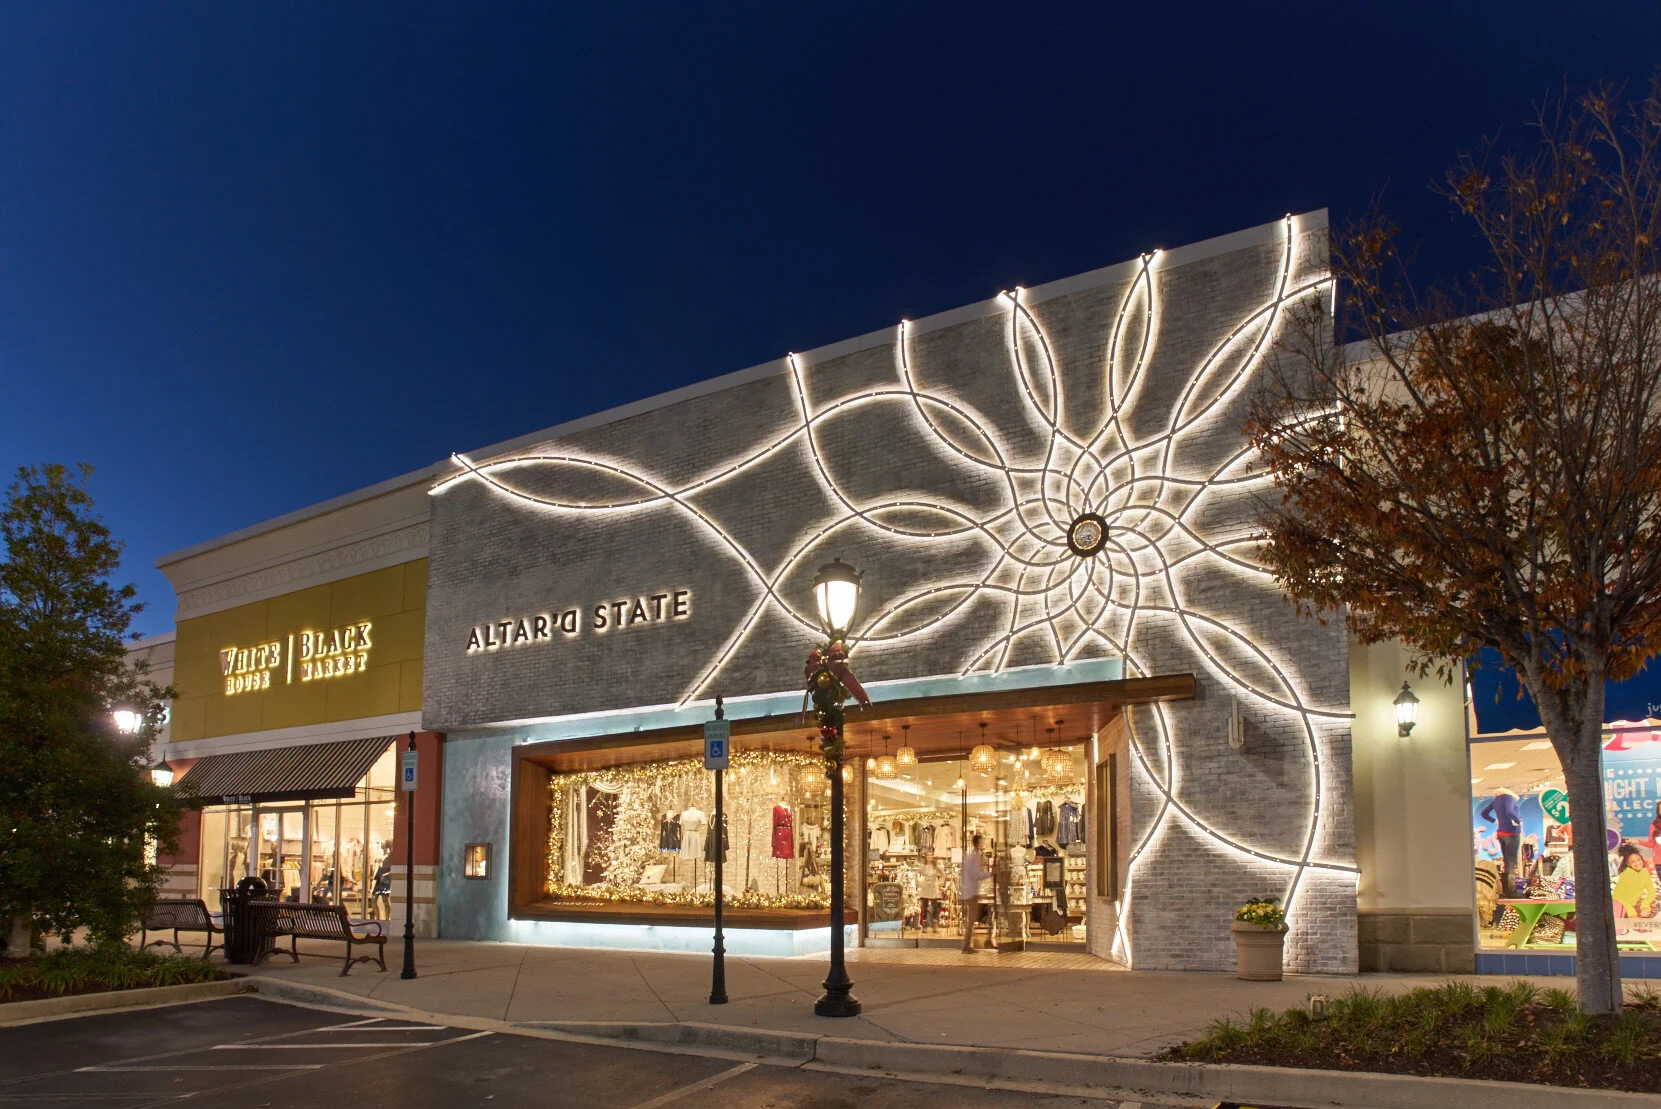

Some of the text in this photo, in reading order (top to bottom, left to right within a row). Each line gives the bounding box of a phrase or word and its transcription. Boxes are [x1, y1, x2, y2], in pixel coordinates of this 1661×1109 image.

[465, 590, 688, 651] ALTAR'D STATE
[220, 622, 372, 676] WHITE BLACK
[226, 652, 368, 695] HOUSE MARKET
